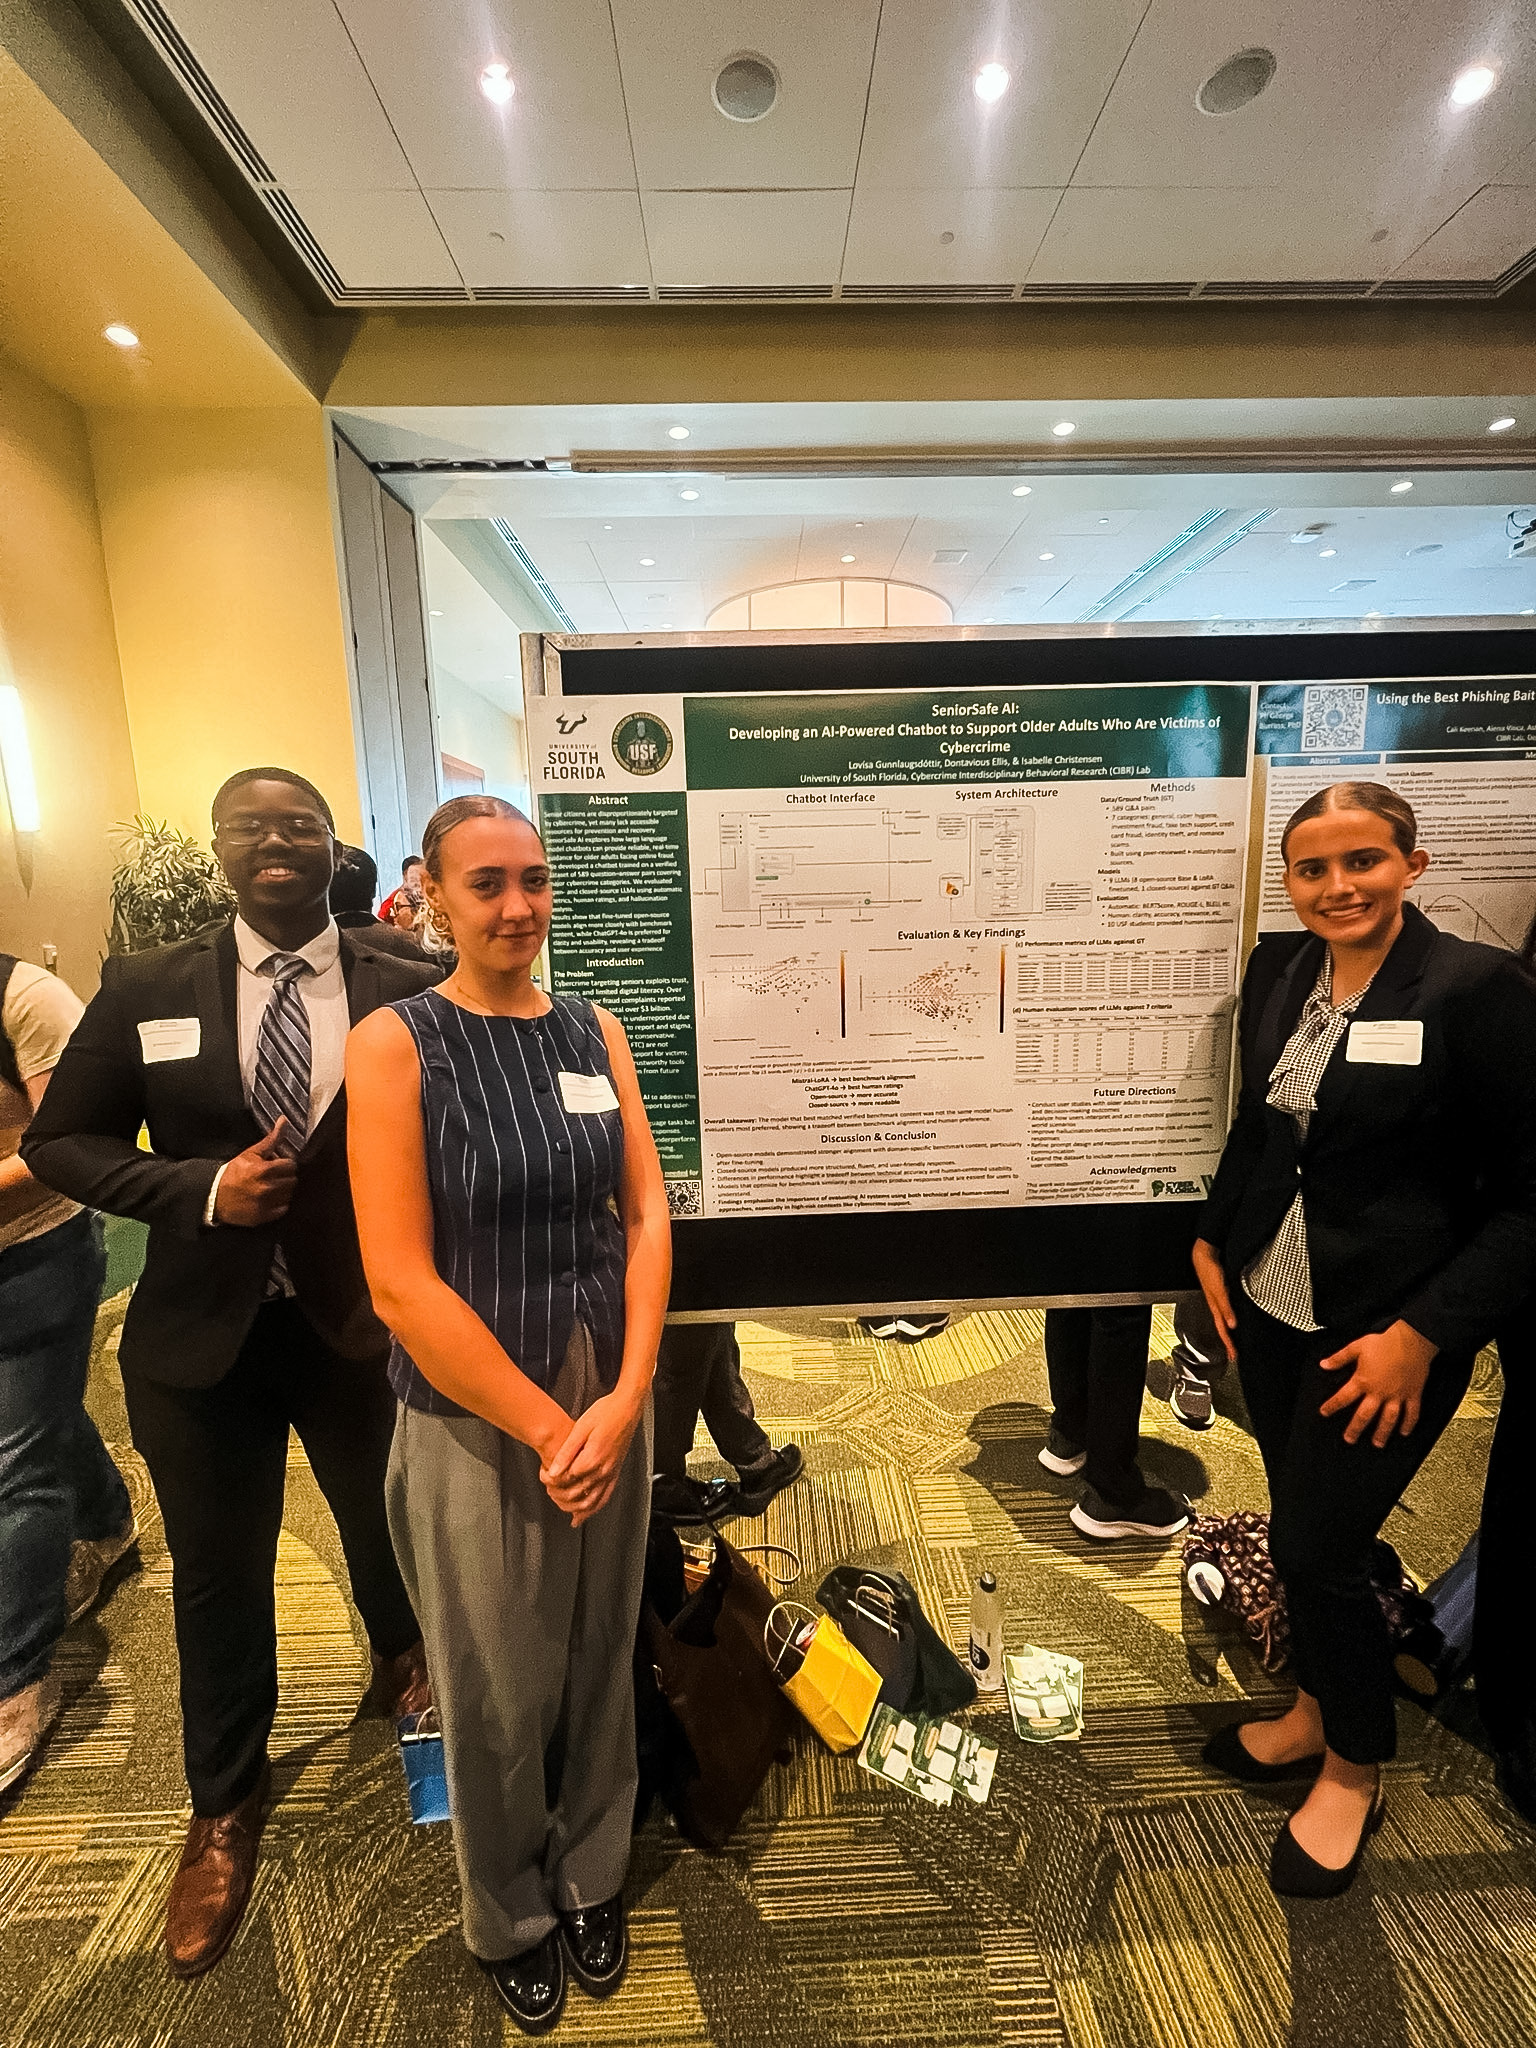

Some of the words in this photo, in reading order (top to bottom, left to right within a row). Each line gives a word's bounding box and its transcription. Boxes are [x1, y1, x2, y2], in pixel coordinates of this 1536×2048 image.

[1377, 693, 1408, 707] Using
[1411, 692, 1430, 703] the
[1433, 691, 1459, 703] Best
[1461, 690, 1510, 705] Phishing
[1512, 689, 1536, 701] Bait
[932, 703, 998, 716] SeniorSafe
[1001, 702, 1019, 714] AI:
[730, 725, 799, 742] Developing
[802, 728, 818, 738] an
[821, 723, 894, 737] AI-Powered
[897, 722, 947, 735] Chatbot
[950, 722, 963, 734] to
[966, 720, 1017, 737] Support
[1020, 719, 1055, 732] Older
[1058, 718, 1099, 731] Adults
[1101, 718, 1131, 730] Who
[1134, 717, 1156, 730] Are
[1159, 716, 1205, 729] Victims
[1208, 715, 1221, 728] of
[630, 744, 657, 760] USF
[940, 740, 1010, 756] Cybercrime
[548, 752, 598, 764] SOUTH
[875, 758, 942, 770] Gunnlaugsdóttir,
[944, 757, 990, 767] Dontavious
[991, 756, 1010, 768] Ellis,
[1012, 756, 1019, 765] &
[1020, 756, 1052, 765] Isabelle
[1054, 754, 1102, 764] Christensen
[544, 766, 605, 780] FLORIDA
[801, 774, 840, 785] University
[842, 773, 851, 782] of
[852, 772, 876, 782] South
[878, 772, 908, 783] Florida,
[910, 770, 956, 782] Cybercrime
[958, 769, 1024, 781] Interdisciplinary
[1025, 768, 1068, 777] Behavioral
[1070, 766, 1107, 776] Research
[1109, 766, 1134, 777] (CIBR)
[1135, 765, 1150, 774] Lab
[1150, 782, 1195, 792] Methods
[588, 795, 628, 804] Abstract
[787, 793, 827, 803] Chatbot
[829, 792, 875, 802] Interface
[956, 789, 992, 802] System
[994, 787, 1058, 798] Architecture
[898, 929, 950, 940] Evaluation
[952, 929, 961, 938] &
[963, 928, 982, 940] Key
[984, 927, 1025, 940] Findings
[1113, 938, 1135, 946] against
[587, 956, 644, 967] Introduction
[555, 979, 589, 988] Cybercrime
[590, 978, 619, 987] targeting
[645, 977, 670, 986] exploits
[671, 977, 688, 985] trust,
[619, 987, 638, 996] digital
[640, 986, 664, 995] literacy.
[621, 996, 656, 1005] complaints
[657, 995, 685, 1004] reported
[1012, 1006, 1021, 1014] (d)
[1122, 1004, 1144, 1012] against
[629, 1014, 676, 1023] underreported
[634, 1023, 654, 1032] report
[669, 1022, 692, 1031] stigma,
[631, 1041, 644, 1049] FTC)
[886, 1073, 916, 1082] alignment
[883, 1082, 903, 1091] ratings
[1094, 1086, 1125, 1096] Future
[1127, 1085, 1176, 1096] Directions
[810, 1092, 847, 1101] Open-source
[726, 1116, 757, 1125] takeaway:
[821, 1132, 871, 1143] Discussion
[873, 1132, 882, 1142] &
[884, 1130, 936, 1141] Conclusion
[1090, 1163, 1176, 1177] Acknowledgments
